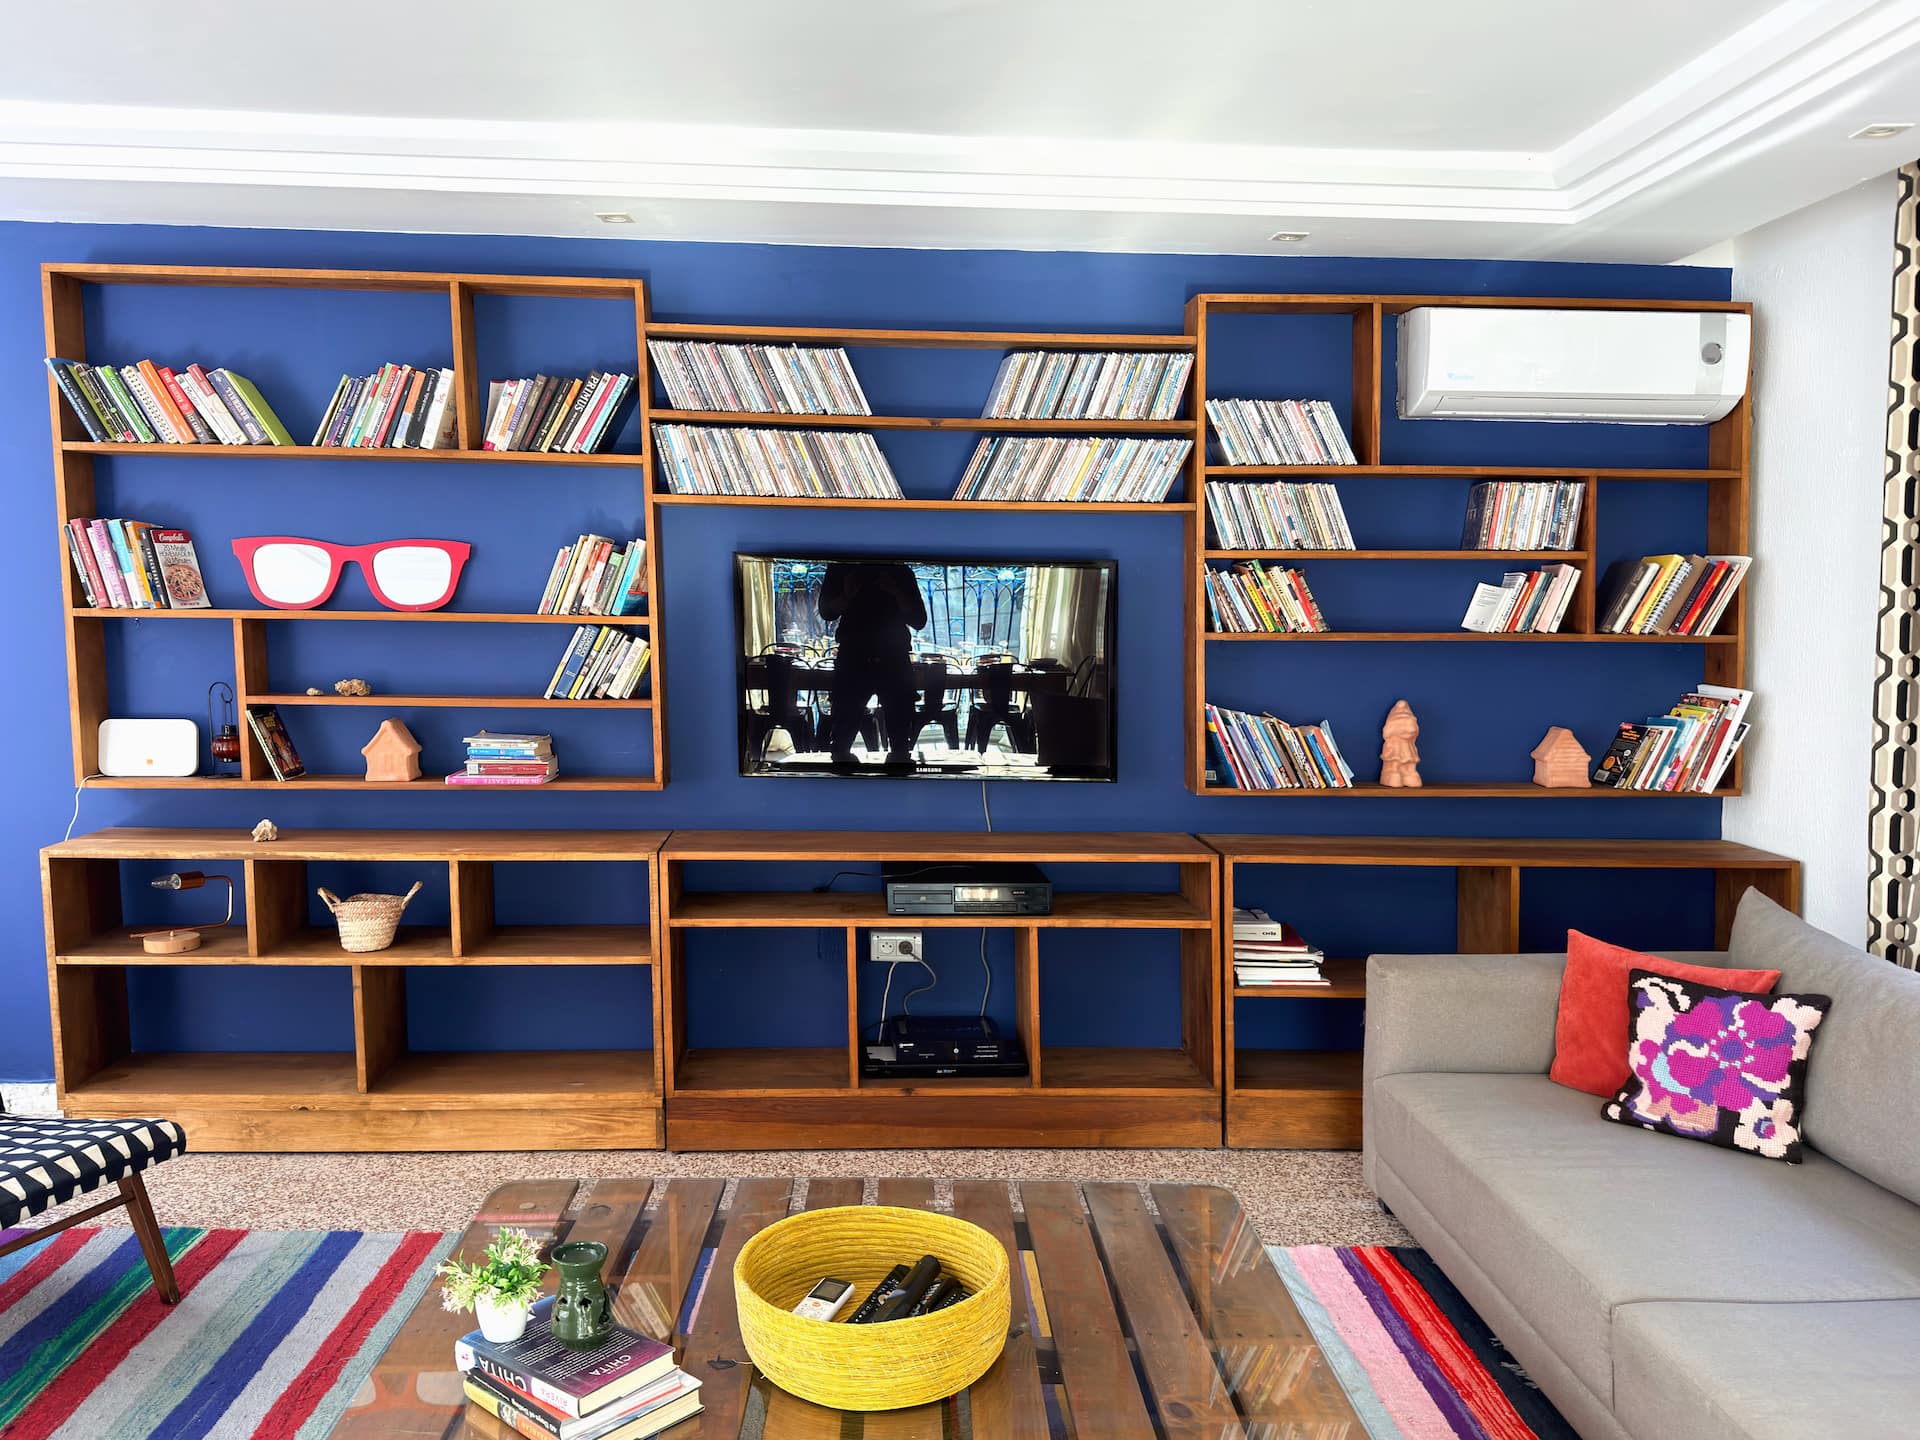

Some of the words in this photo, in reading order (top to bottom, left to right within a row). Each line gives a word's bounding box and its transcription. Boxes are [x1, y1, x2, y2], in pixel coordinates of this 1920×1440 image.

[225, 386, 250, 420] BASEBALL
[574, 375, 600, 412] PRIMUS
[478, 1357, 527, 1392] CHITA
[589, 1355, 632, 1376] CHITA
